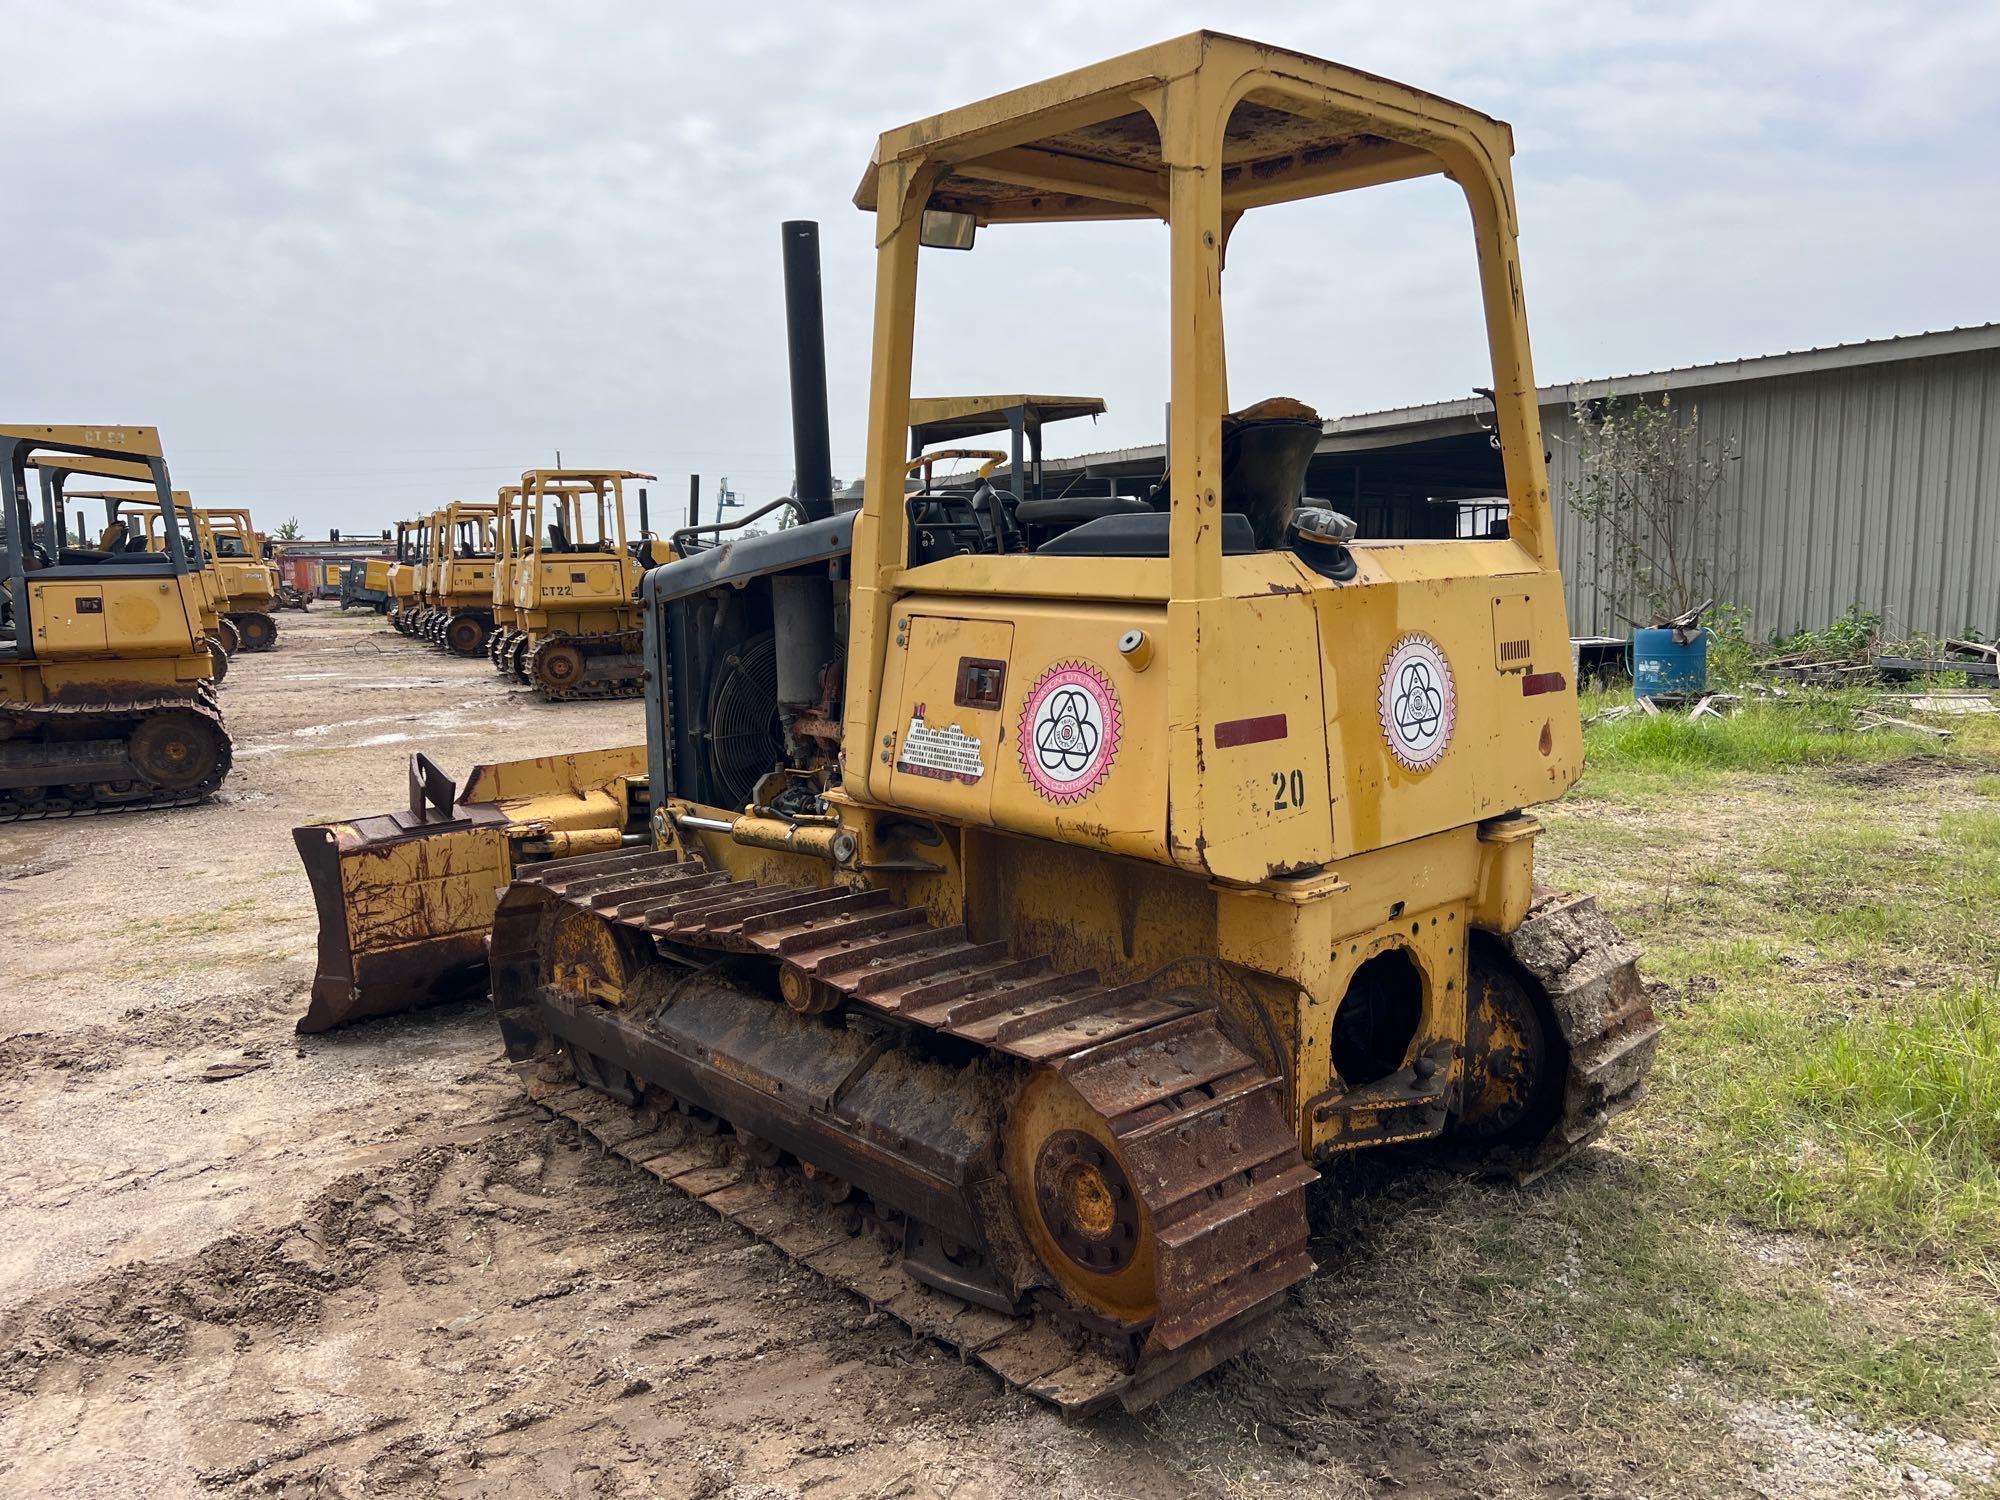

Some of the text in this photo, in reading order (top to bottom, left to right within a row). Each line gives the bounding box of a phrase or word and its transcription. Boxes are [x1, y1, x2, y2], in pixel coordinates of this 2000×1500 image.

[541, 585, 571, 596] CT22
[939, 732, 963, 741] CONVICTION
[1272, 769, 1304, 810] 20
